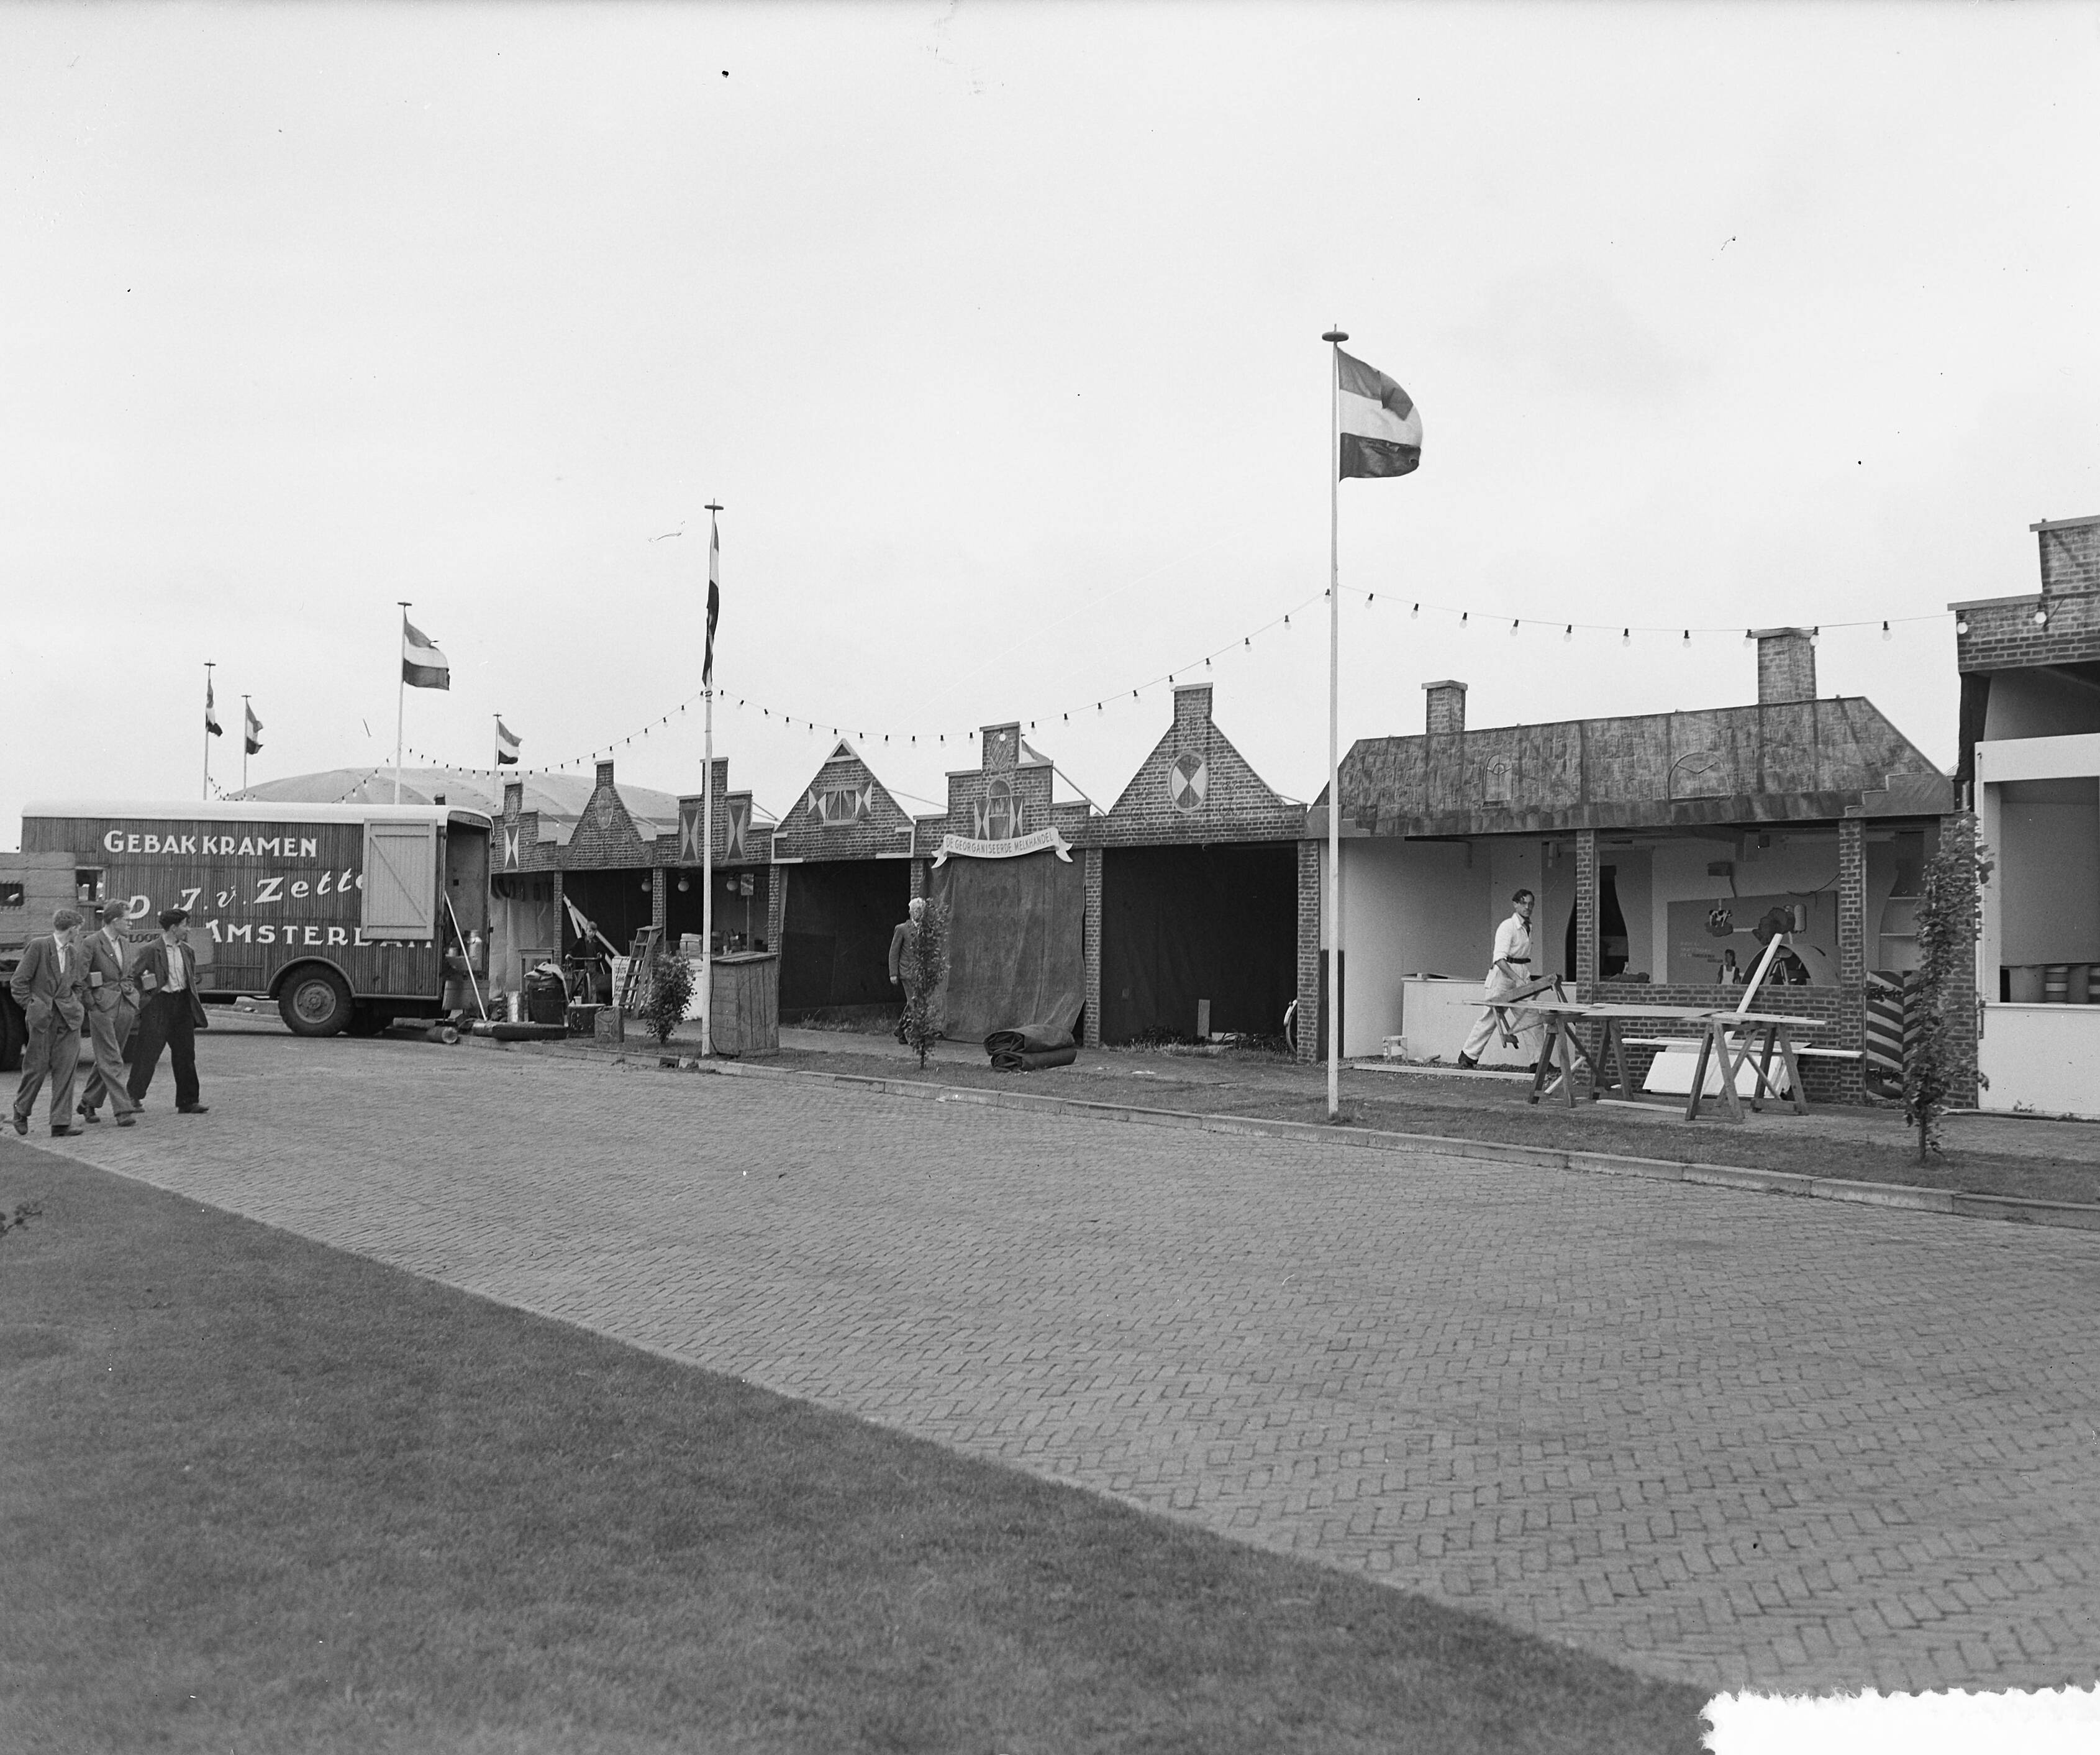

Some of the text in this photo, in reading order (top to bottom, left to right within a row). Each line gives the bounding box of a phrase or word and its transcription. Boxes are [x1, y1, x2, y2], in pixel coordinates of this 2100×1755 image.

[946, 831, 1054, 854] DE GEORGANISEERDE MELKHANDEL
